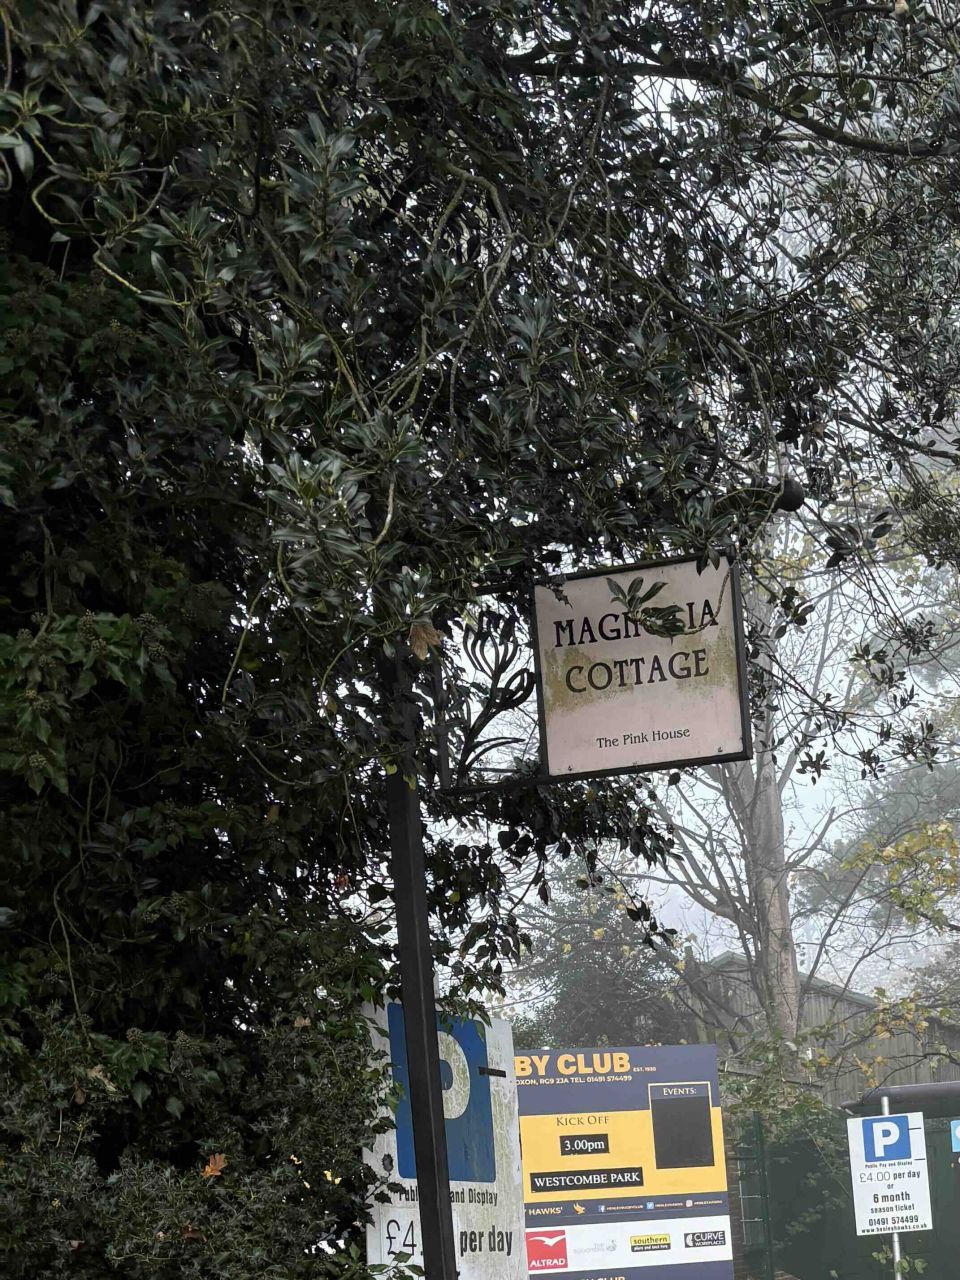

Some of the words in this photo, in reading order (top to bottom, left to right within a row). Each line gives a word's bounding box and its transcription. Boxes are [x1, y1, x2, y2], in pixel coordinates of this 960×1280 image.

[553, 599, 719, 648] MAGNIA
[566, 648, 710, 693] COTTAGE
[596, 736, 619, 749] The
[623, 733, 649, 746] Pink
[652, 728, 691, 742] House
[557, 1052, 631, 1076] CLUB
[539, 1077, 555, 1085] RG9
[586, 1075, 606, 1083] 01491
[564, 1139, 605, 1153] 3.00pm
[872, 1121, 900, 1158] P
[534, 1173, 608, 1188] WESTCOMBE
[610, 1172, 641, 1183] PARK
[859, 1171, 891, 1183] £4.00
[893, 1171, 905, 1181] per
[907, 1169, 921, 1180] day
[468, 1188, 498, 1207] Display
[873, 1193, 879, 1204] 6
[881, 1191, 911, 1203] month
[870, 1205, 894, 1214] season
[895, 1203, 915, 1212] ticket
[868, 1217, 889, 1227] 01491
[891, 1215, 919, 1225] 574499
[459, 1230, 485, 1257] per
[488, 1225, 513, 1256] day
[633, 1236, 668, 1245] southern
[694, 1231, 725, 1242] CURVE
[529, 1257, 566, 1268] ALTRAD
